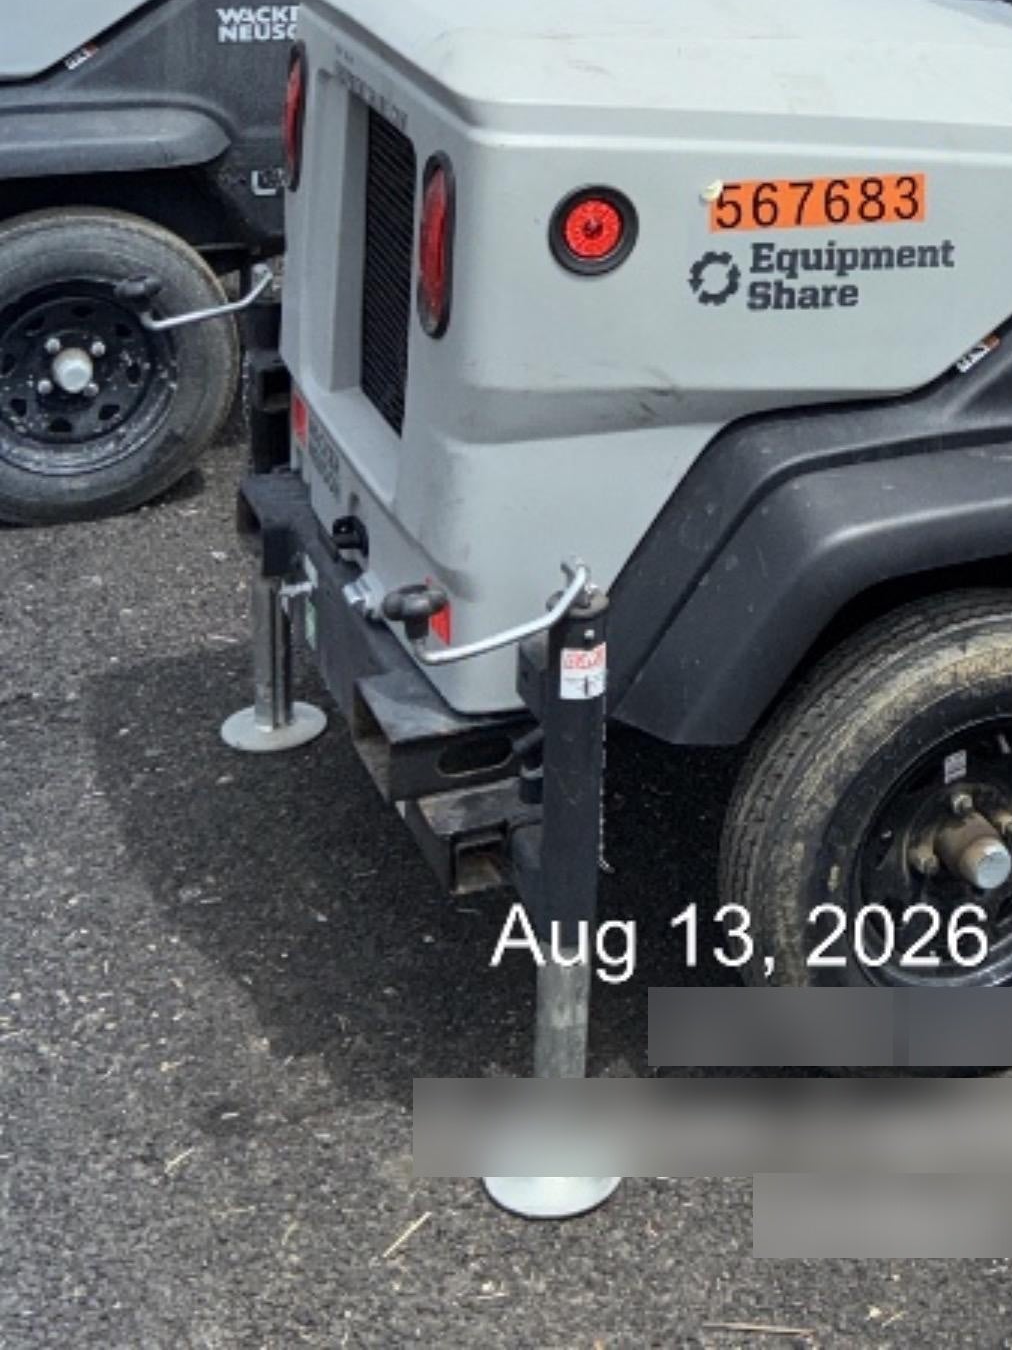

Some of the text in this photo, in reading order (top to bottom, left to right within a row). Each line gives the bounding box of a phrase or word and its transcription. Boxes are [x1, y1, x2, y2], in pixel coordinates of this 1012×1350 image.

[716, 176, 919, 229] 567683
[750, 240, 955, 280] Equipment
[747, 279, 859, 311] Share
